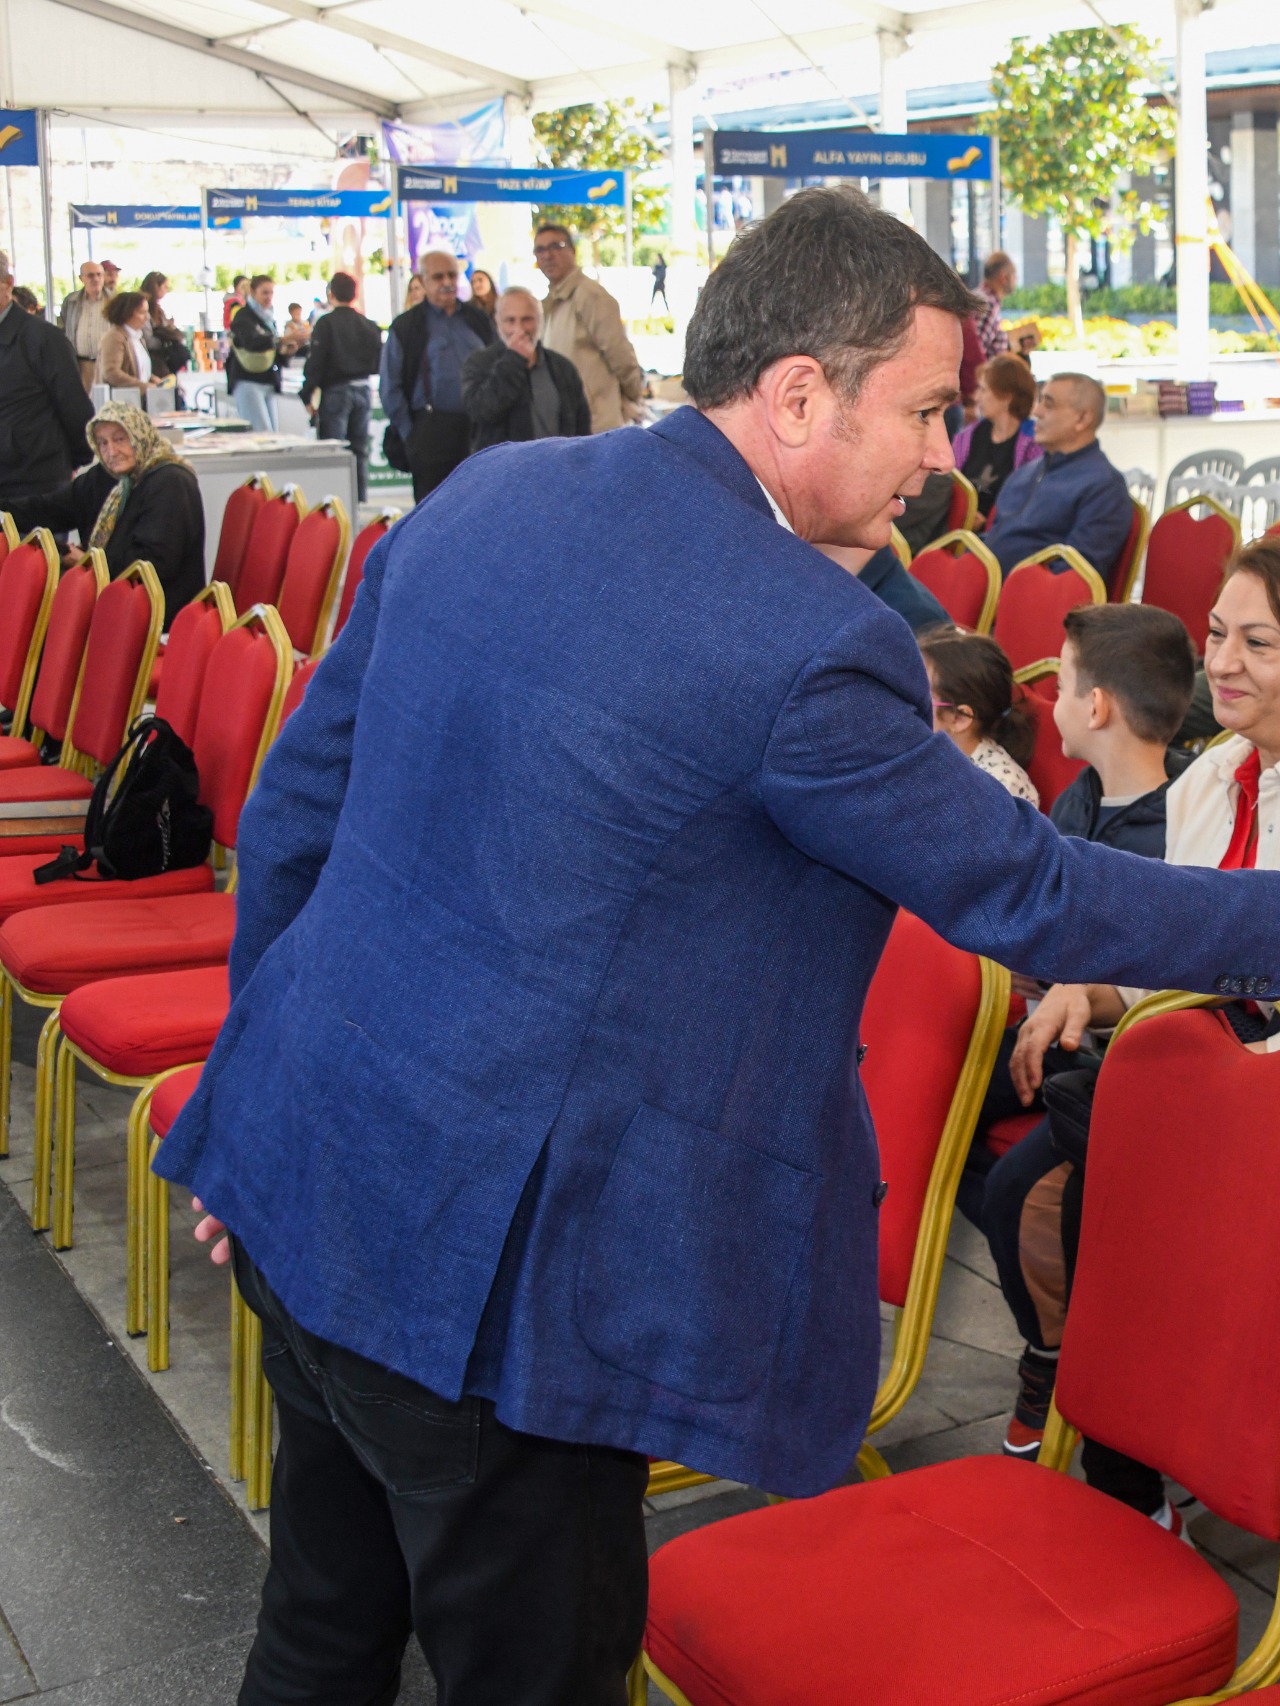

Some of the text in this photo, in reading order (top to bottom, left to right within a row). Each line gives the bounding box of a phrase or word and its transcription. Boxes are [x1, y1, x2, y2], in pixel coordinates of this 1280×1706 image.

[813, 150, 927, 166] ALFA YAYIN GRUBU
